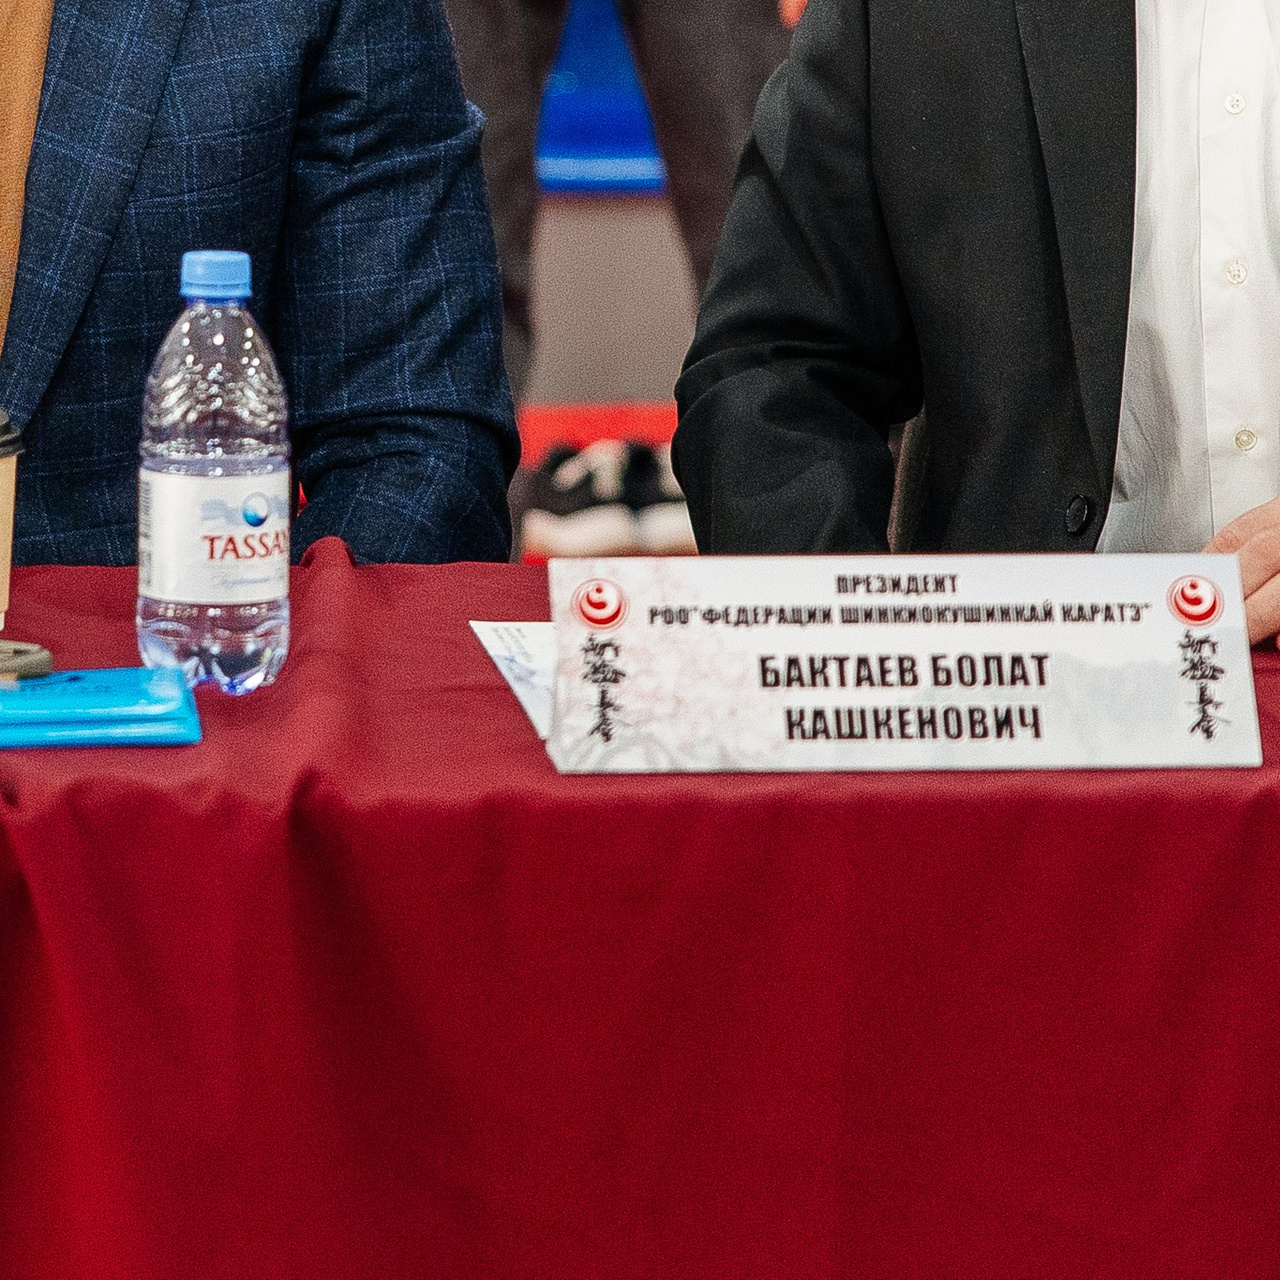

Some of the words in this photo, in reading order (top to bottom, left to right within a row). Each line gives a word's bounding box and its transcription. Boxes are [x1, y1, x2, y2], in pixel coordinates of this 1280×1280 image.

[836, 574, 958, 595] ПРЕЗИДЕНТ
[760, 654, 920, 688] БАКТАЕВ
[930, 653, 1049, 687] БОЛАТ
[785, 705, 1042, 740] КАШКЕНОВИЧ
